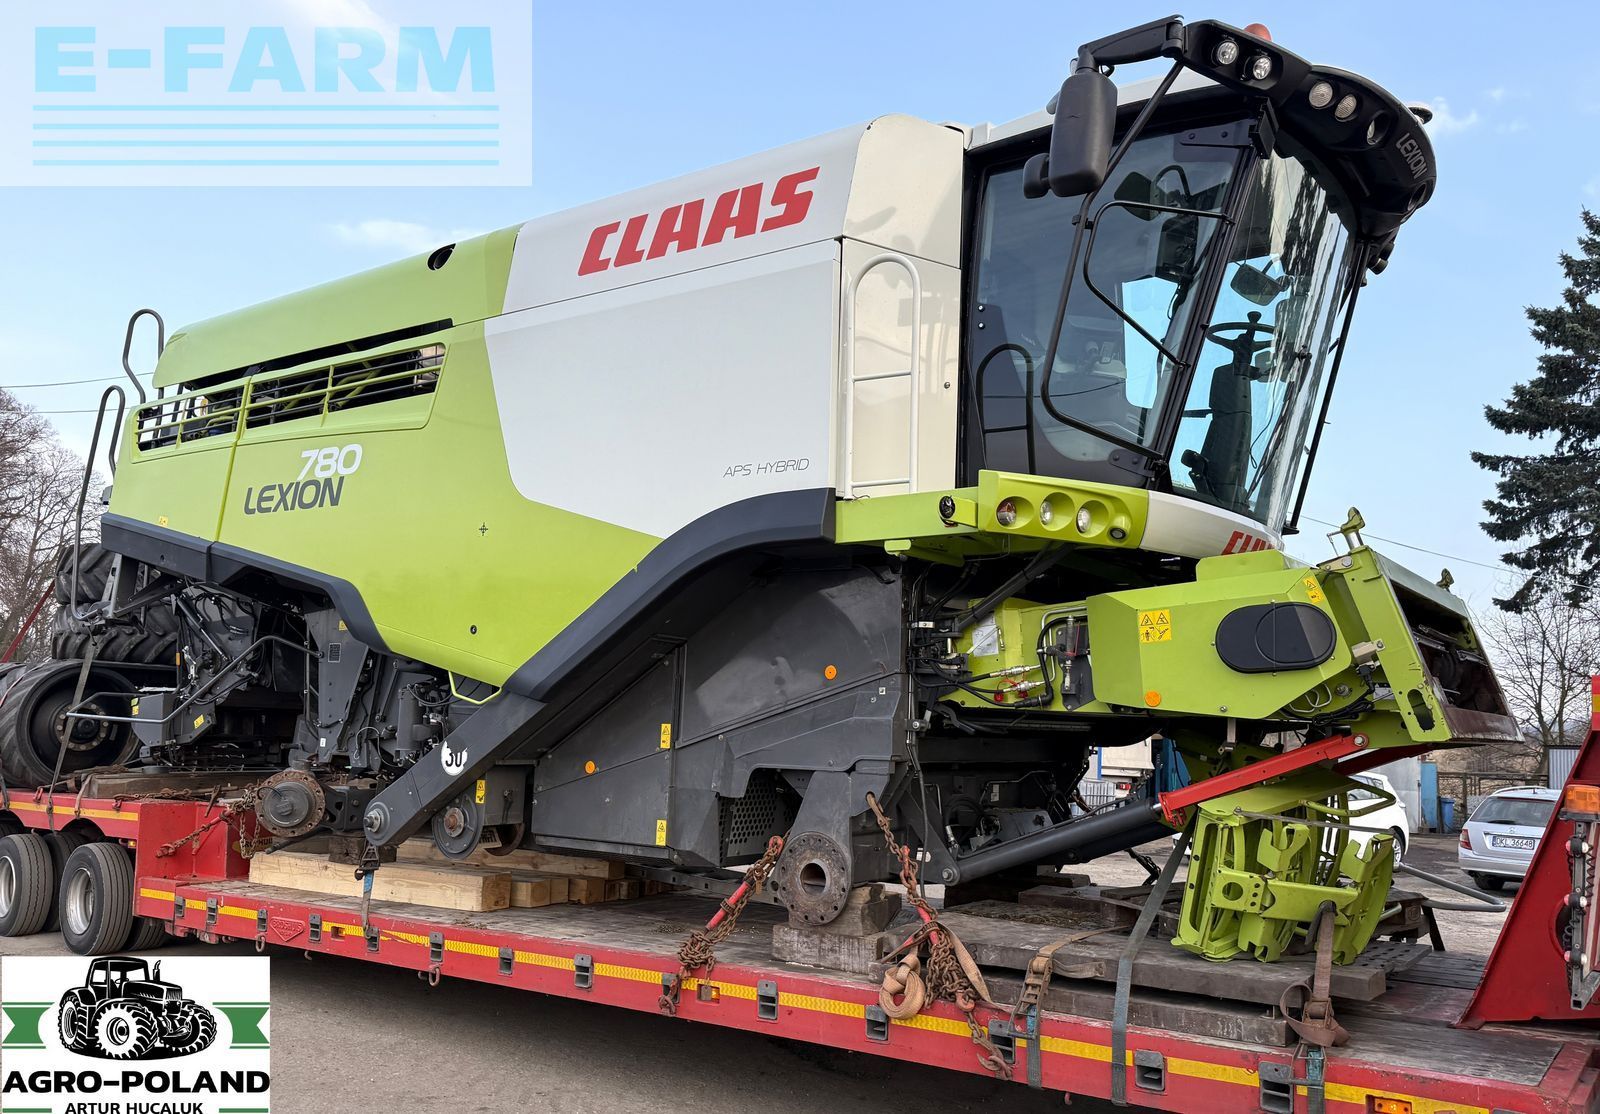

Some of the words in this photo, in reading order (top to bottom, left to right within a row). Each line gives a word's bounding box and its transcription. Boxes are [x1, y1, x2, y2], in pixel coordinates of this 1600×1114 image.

[1395, 132, 1428, 180] LEXION
[577, 166, 821, 277] CLAAS
[297, 443, 363, 480] 780
[722, 463, 752, 478] APS
[756, 458, 810, 475] HYBRID
[243, 475, 345, 515] LEXION
[1221, 530, 1275, 555] CLA
[1511, 838, 1533, 848] 36648
